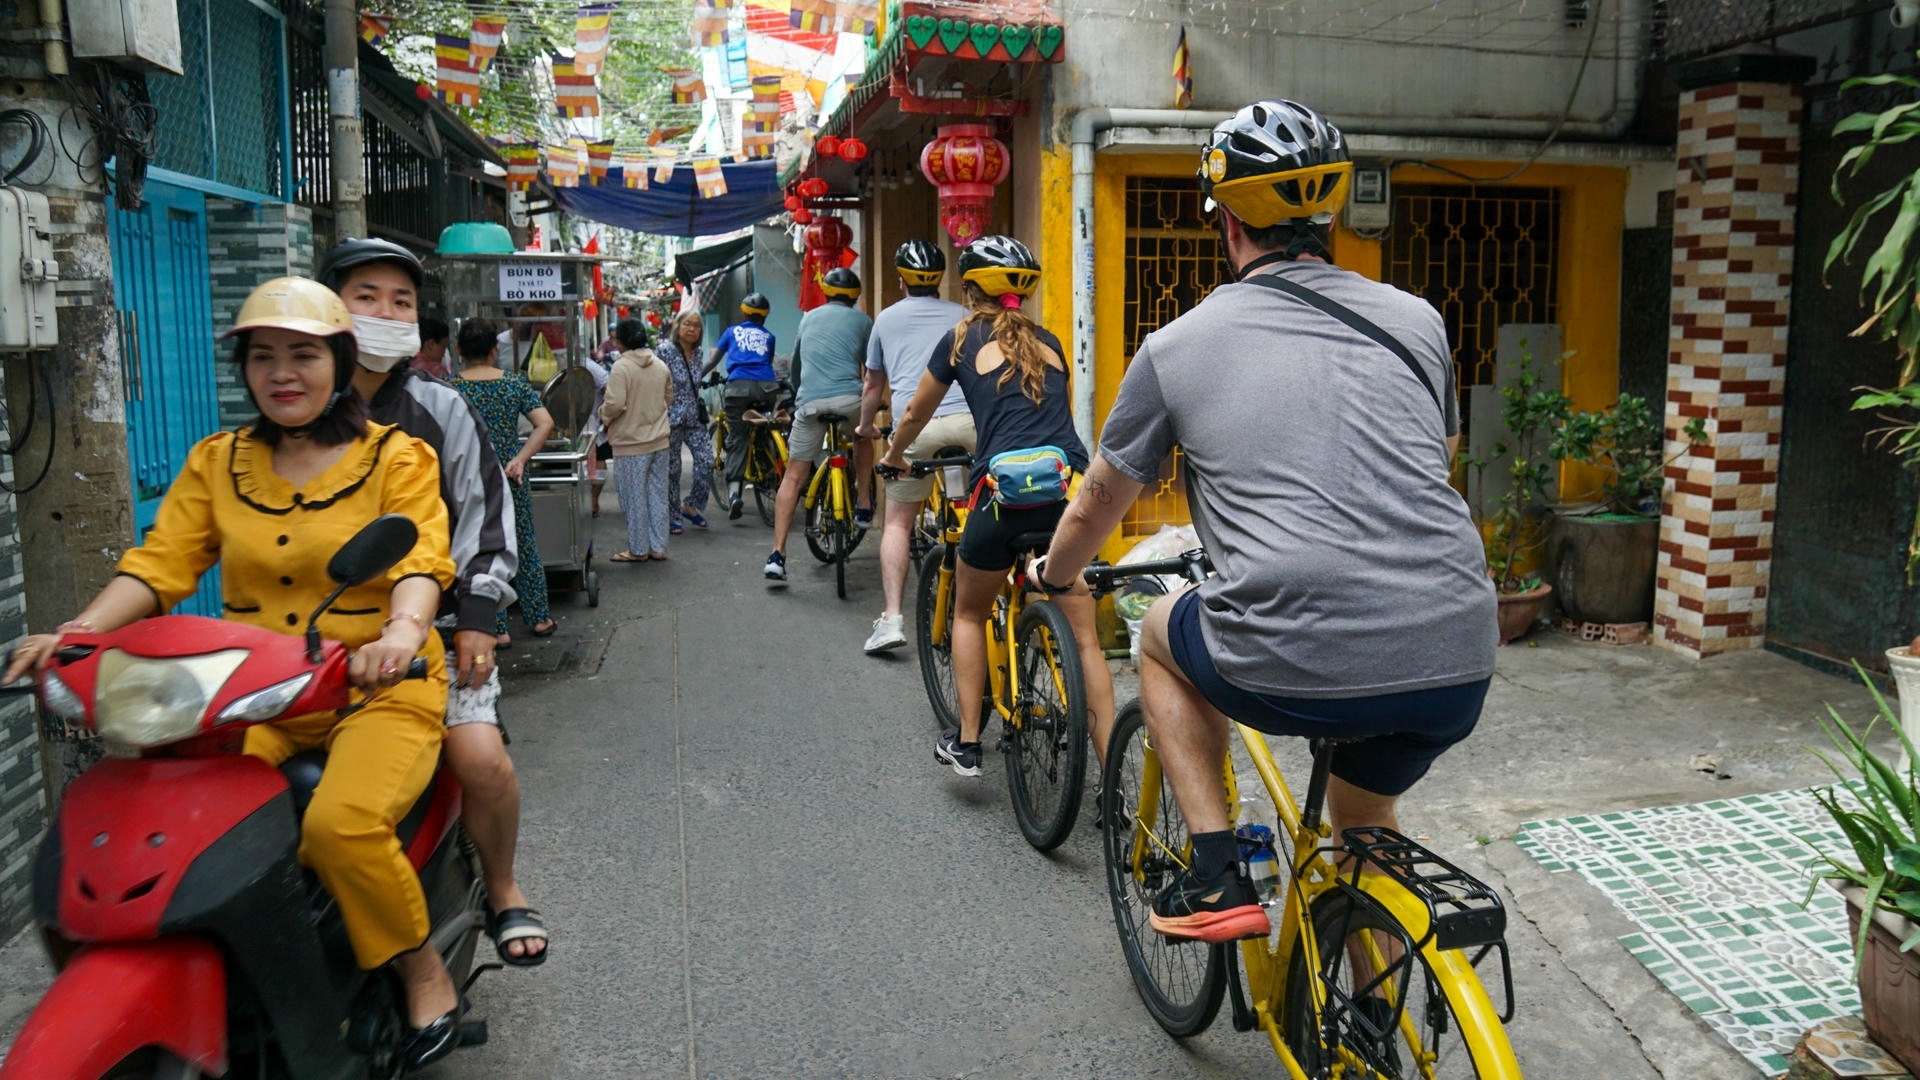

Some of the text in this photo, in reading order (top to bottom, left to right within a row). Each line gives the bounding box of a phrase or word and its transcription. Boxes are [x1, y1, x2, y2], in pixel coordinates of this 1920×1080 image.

[1210, 158, 1224, 174] 05
[507, 265, 554, 277] BÚN BÒ
[507, 288, 556, 299] BÒ KHO
